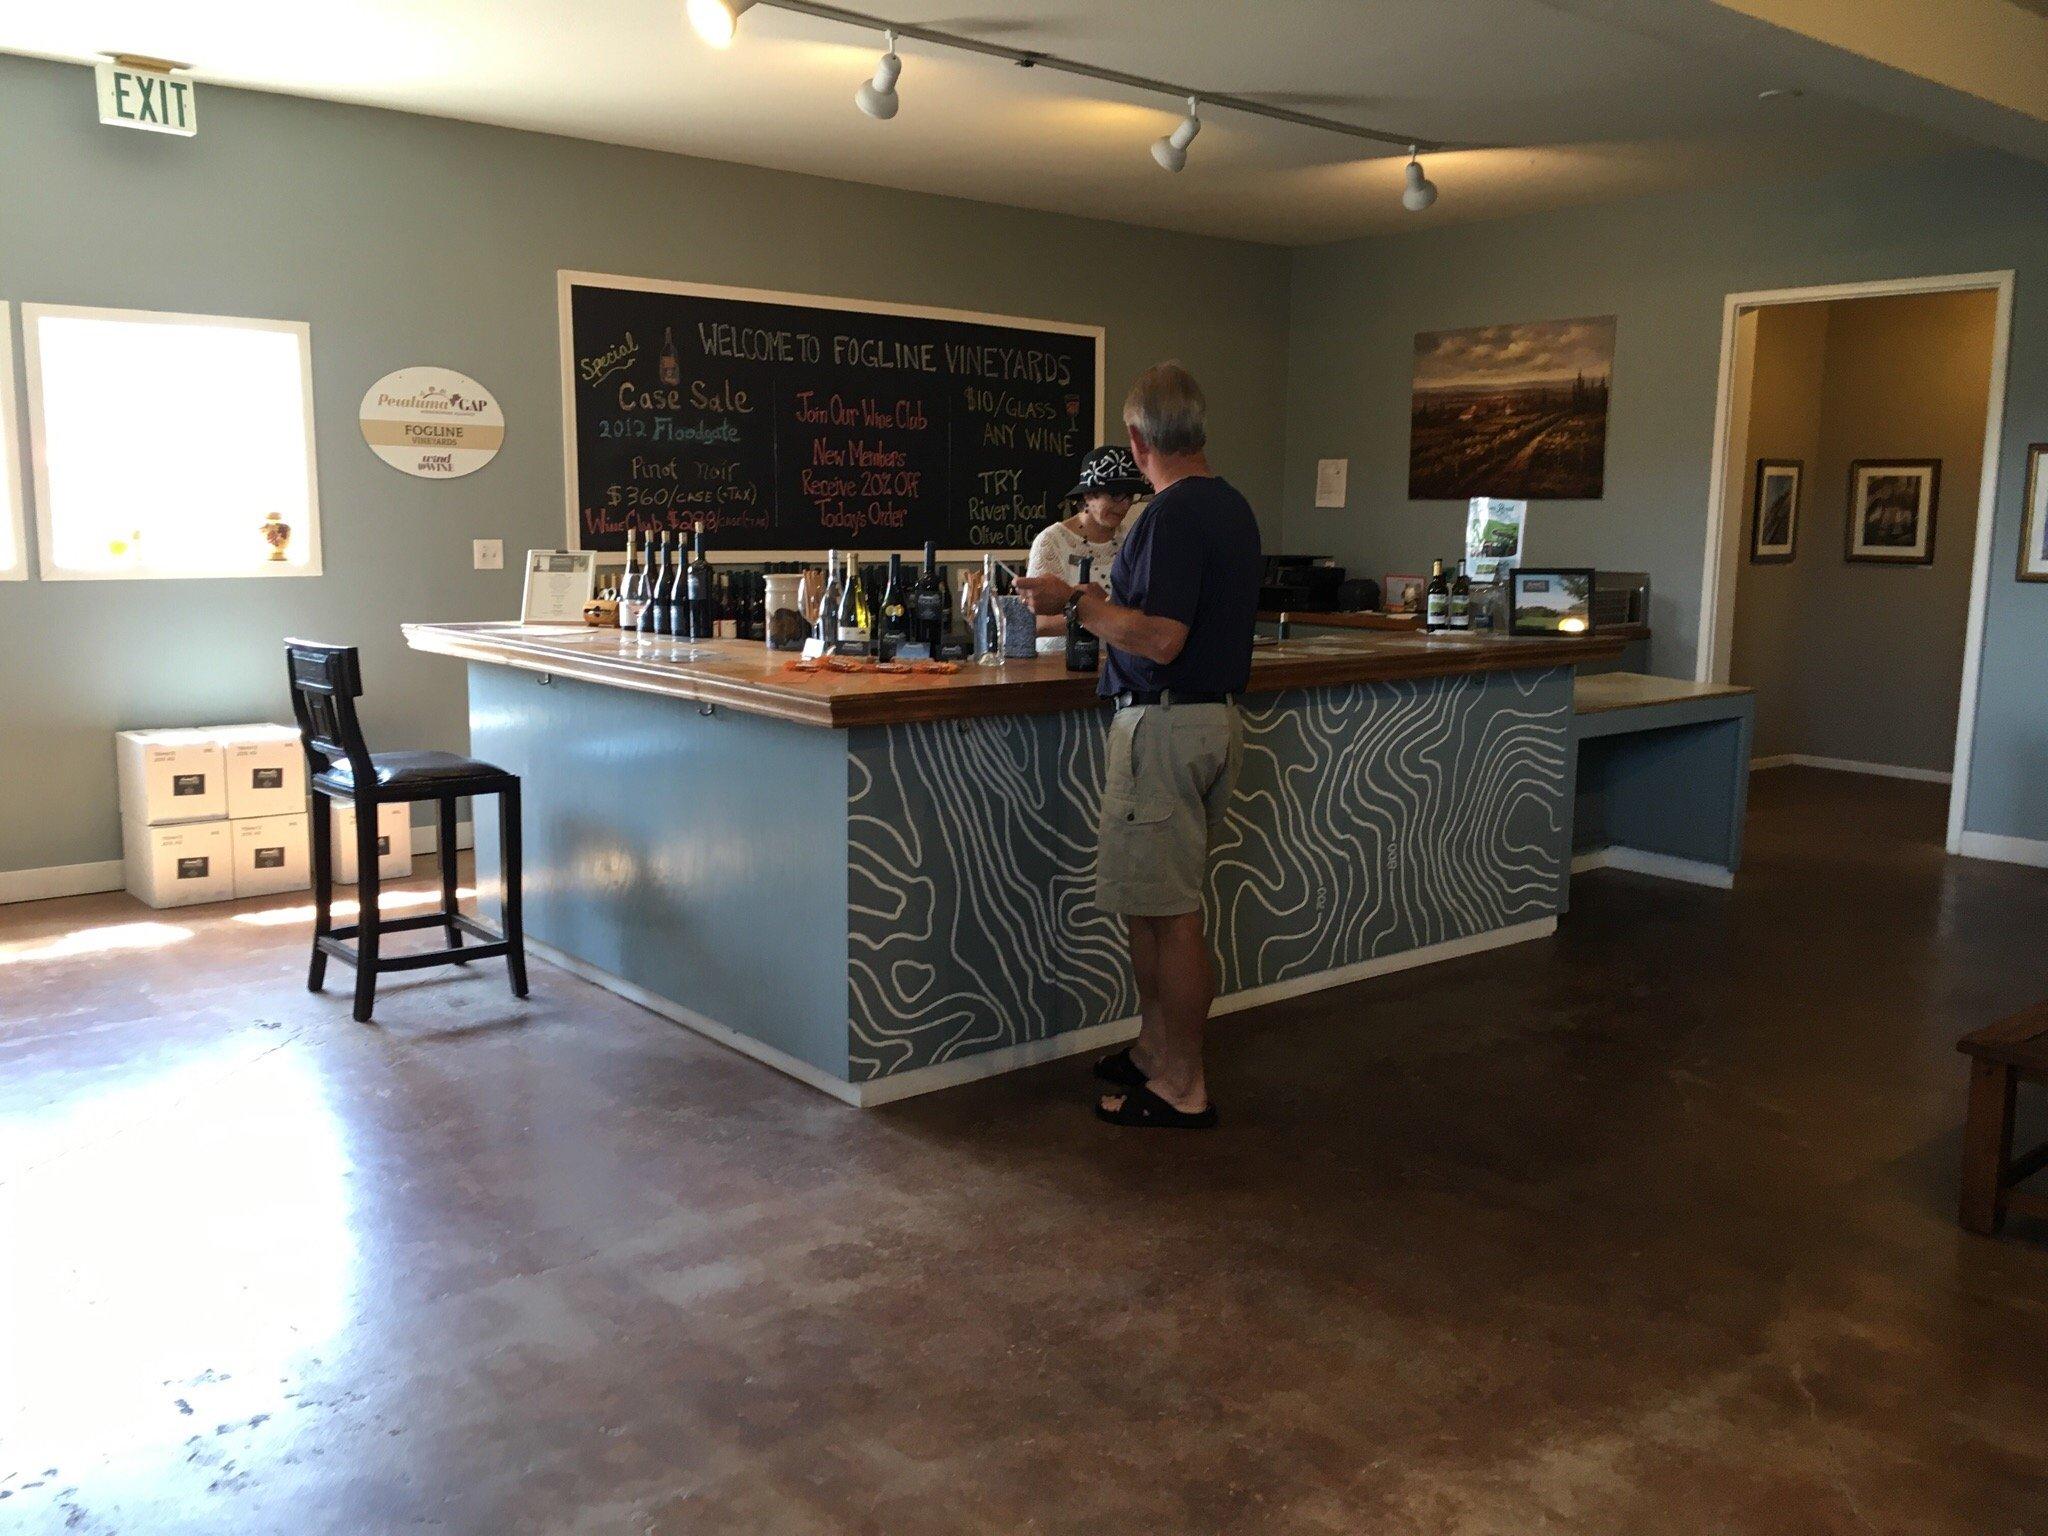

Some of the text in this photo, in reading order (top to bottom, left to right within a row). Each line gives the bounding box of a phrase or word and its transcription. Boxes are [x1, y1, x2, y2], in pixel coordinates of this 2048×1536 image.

[114, 72, 188, 127] EXIT
[580, 331, 639, 381] Special
[698, 322, 1073, 386] WELCOME TO FOGLINE VINEYARDS
[377, 393, 487, 412] Petaluma GAP
[618, 378, 754, 413] Case Sale
[796, 390, 928, 430] Join Our Wine Club
[964, 385, 1056, 419] $10/GLASS
[404, 424, 463, 438] FOGLINE
[412, 437, 457, 446] VINEYARDS
[599, 416, 741, 445] 2012 Floodgate
[983, 421, 1075, 457] ANY WINE
[812, 436, 906, 467] New Members
[632, 455, 678, 479] Pinot
[978, 468, 1023, 495] TRY
[801, 468, 857, 497] Receive
[861, 471, 892, 497] 20%
[868, 501, 907, 527] Order
[968, 490, 1047, 521] River Road
[969, 524, 1004, 546] Olive
